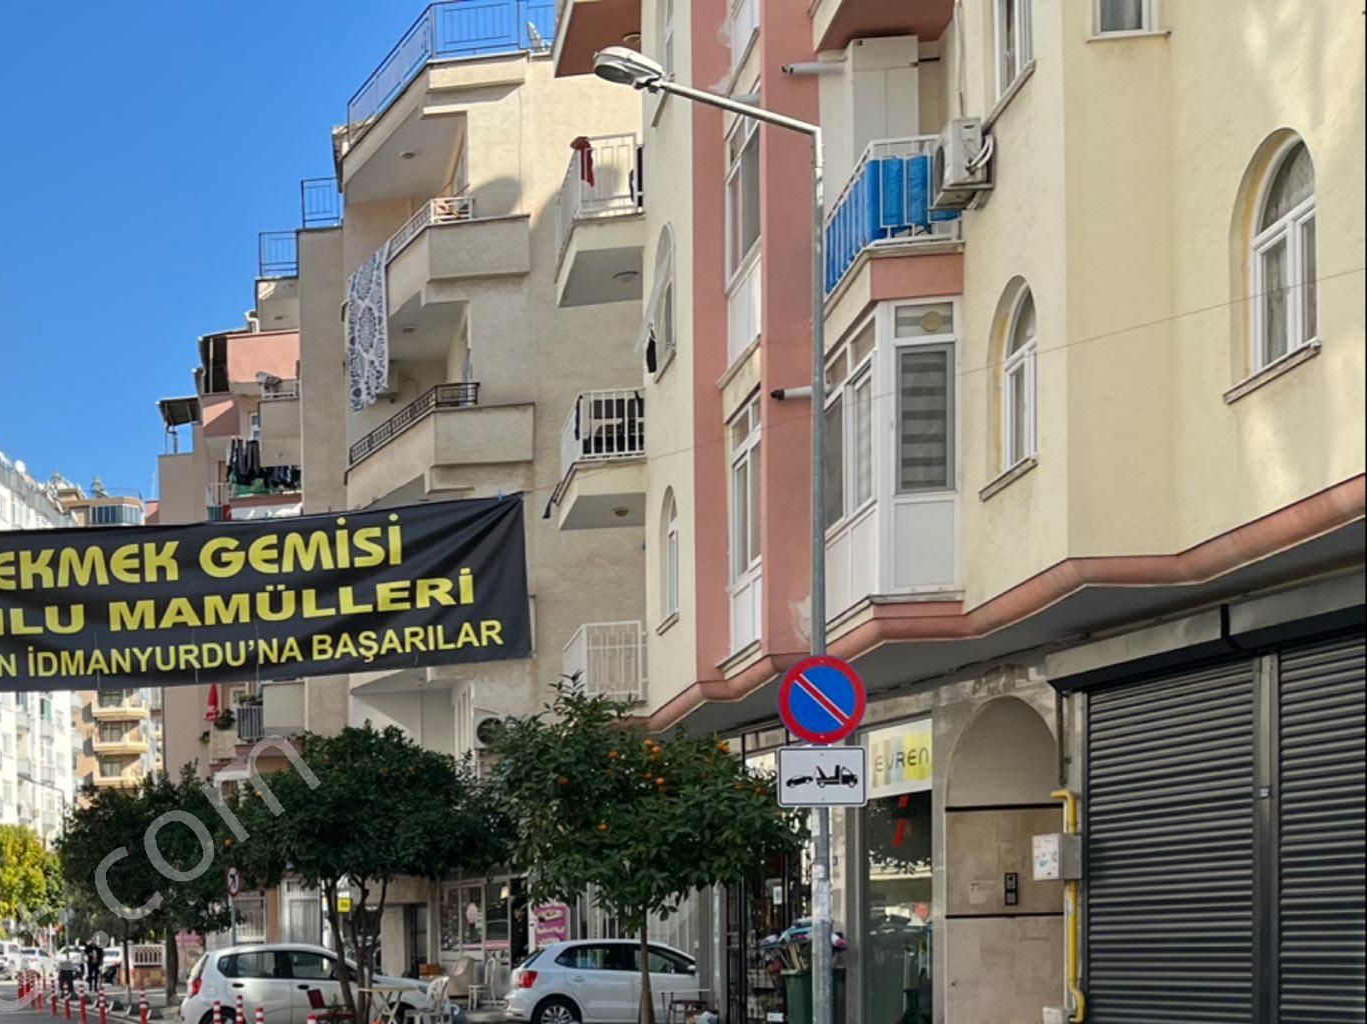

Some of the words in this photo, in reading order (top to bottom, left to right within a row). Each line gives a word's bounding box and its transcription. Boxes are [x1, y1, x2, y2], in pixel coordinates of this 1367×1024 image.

[199, 513, 402, 578] GEMİSİ
[109, 567, 475, 632] MAMÜLLERİ
[312, 620, 504, 662] BAŞARILAR
